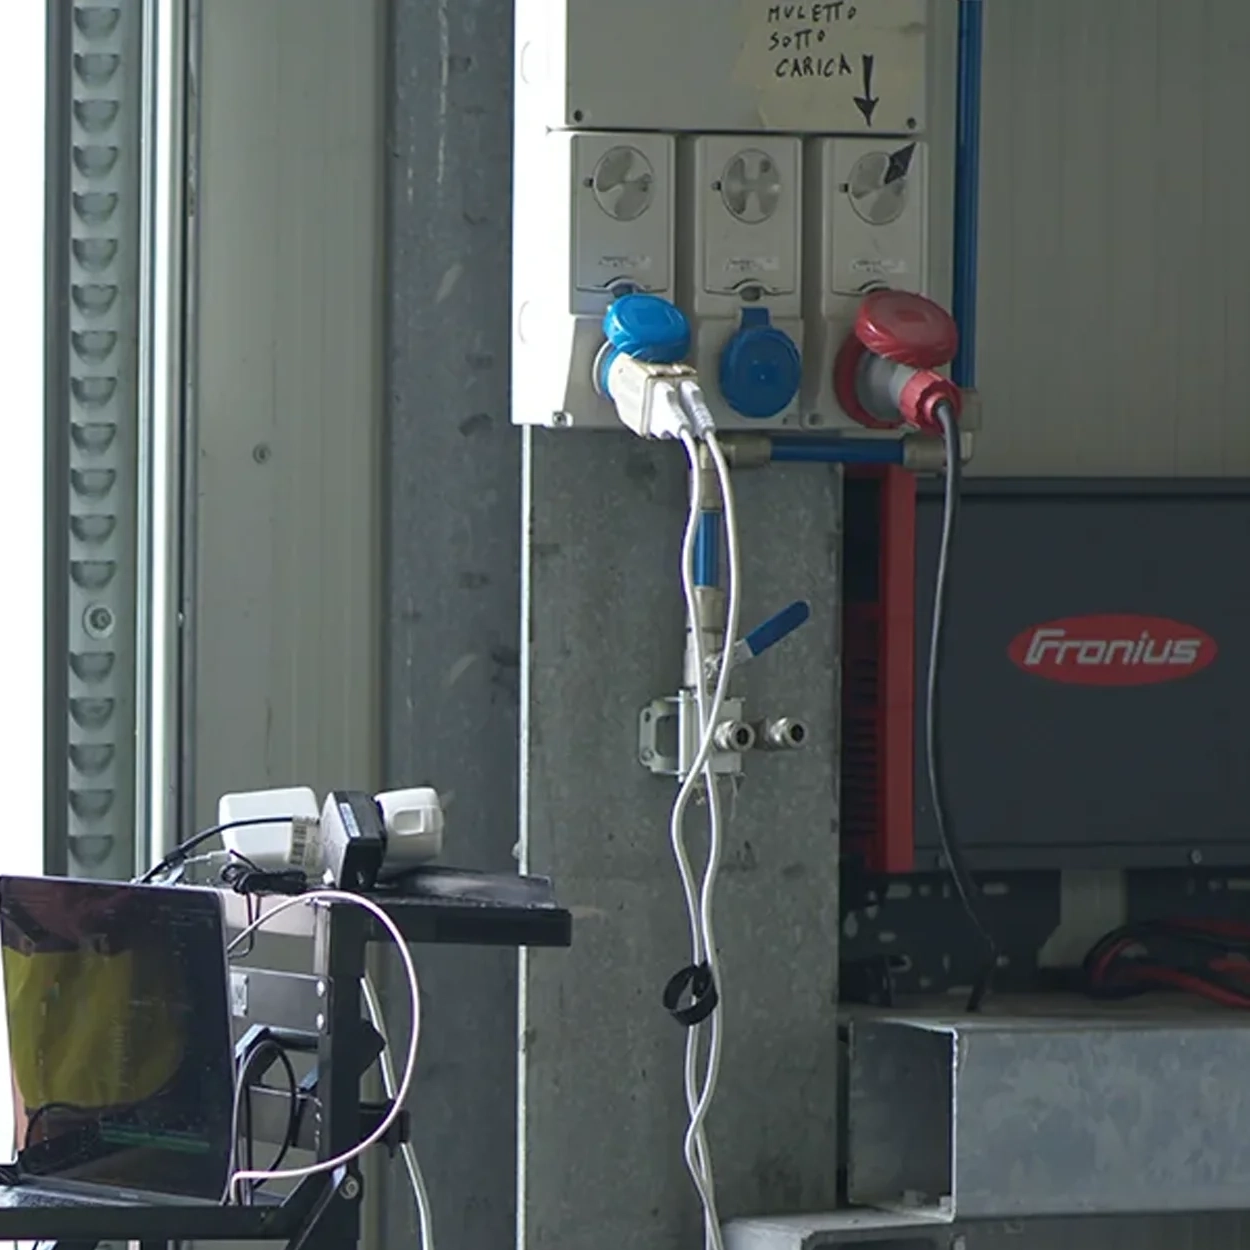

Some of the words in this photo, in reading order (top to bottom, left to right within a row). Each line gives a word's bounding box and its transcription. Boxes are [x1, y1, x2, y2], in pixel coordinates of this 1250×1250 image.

[767, 1, 857, 22] MULETTO
[768, 29, 826, 51] SOTTO
[775, 53, 852, 77] CARICA
[1023, 629, 1202, 666] Fronius
